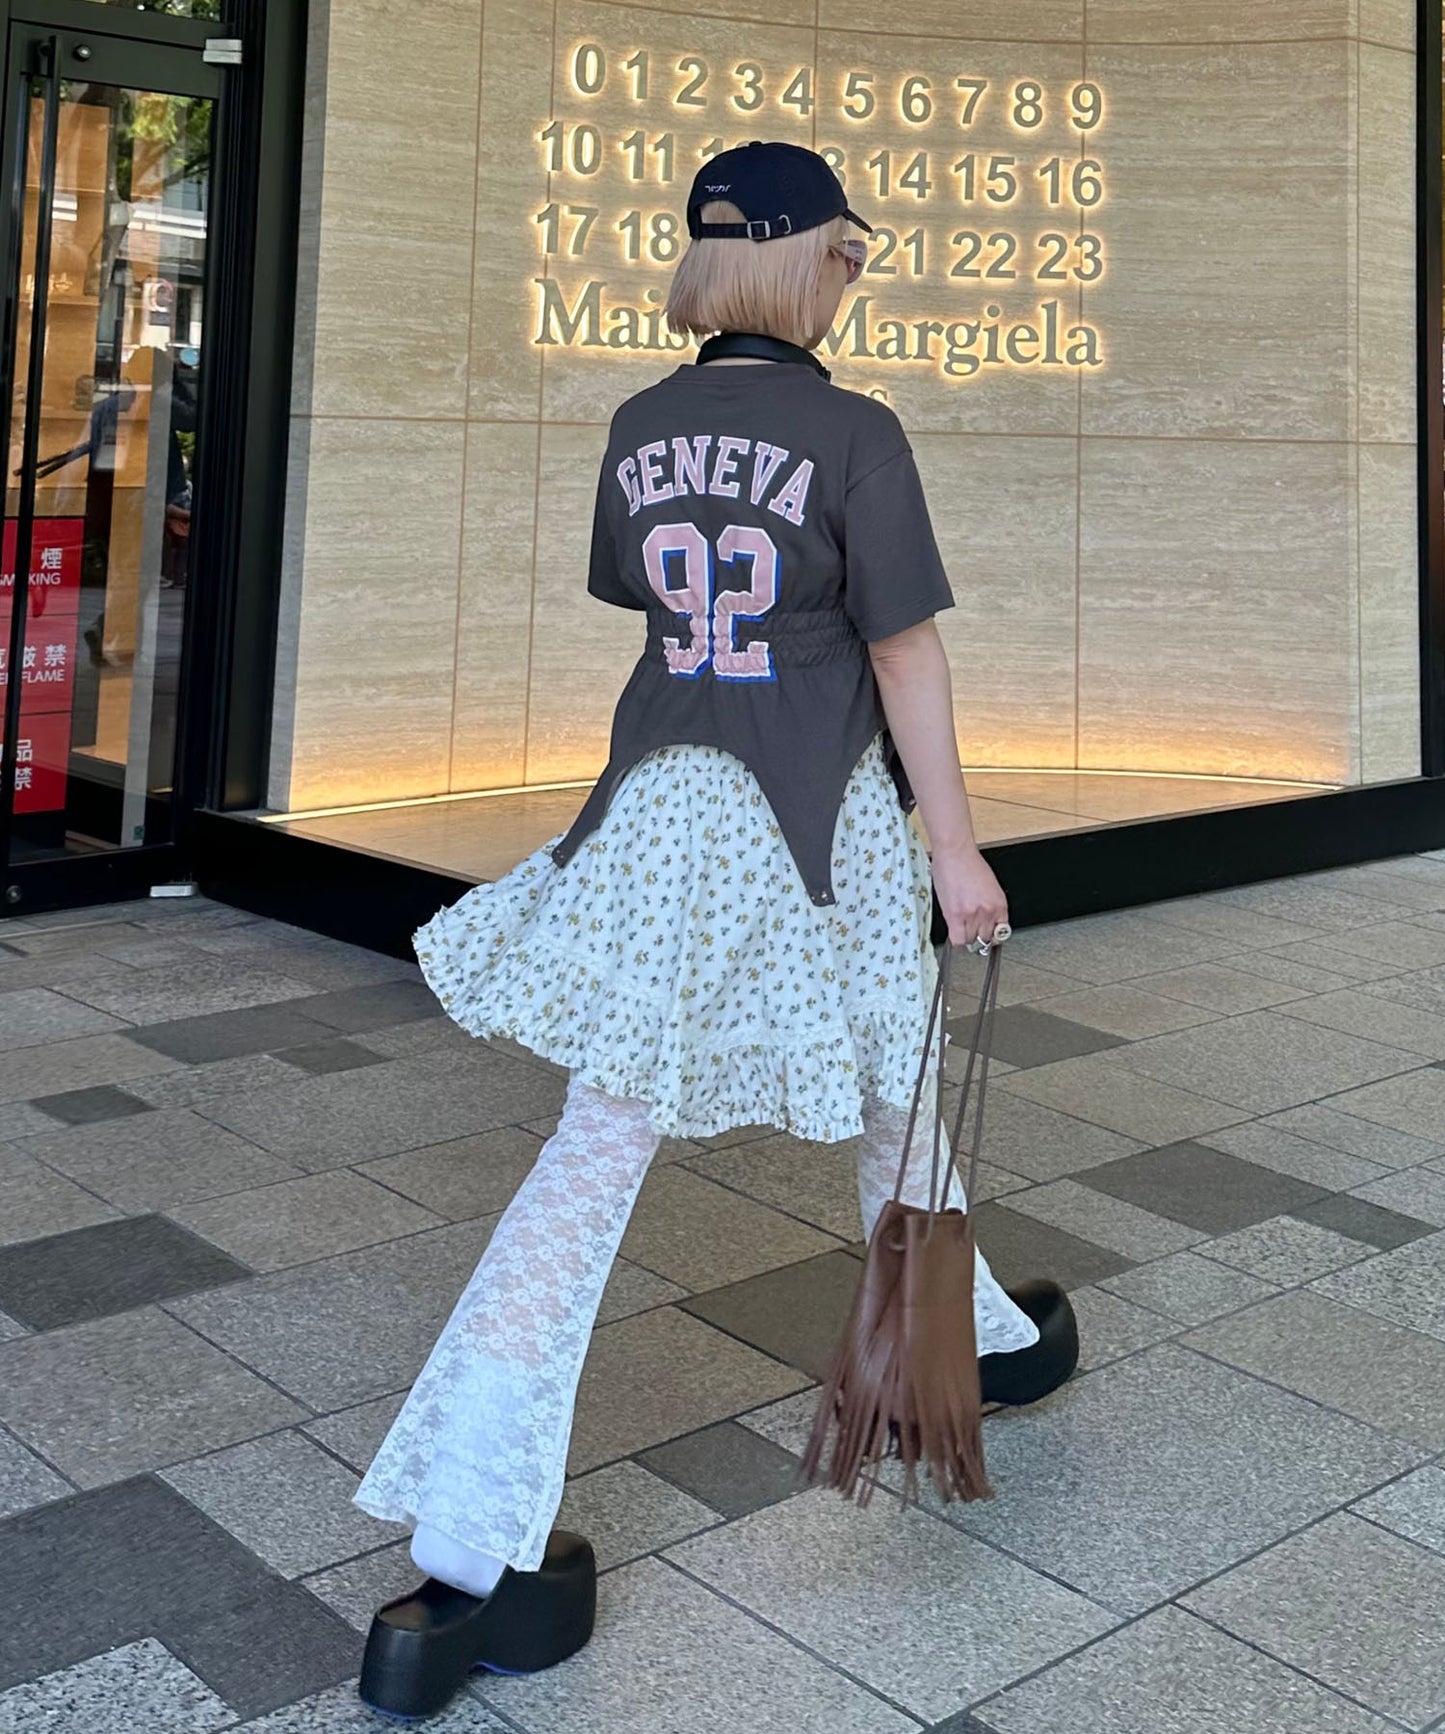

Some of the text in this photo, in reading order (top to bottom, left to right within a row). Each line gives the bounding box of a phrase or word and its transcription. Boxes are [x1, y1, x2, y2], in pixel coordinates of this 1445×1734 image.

[574, 43, 1103, 129] 0 1 2 3 4 5 6 7 8 9
[541, 121, 601, 175] 10
[622, 130, 674, 182] 11
[869, 150, 932, 199] 14
[954, 154, 1017, 203] 15
[1039, 157, 1103, 207] 16
[537, 203, 1103, 281] 17 18 21 22 23
[534, 278, 1103, 377] Mai Margiela
[616, 435, 815, 527] GENEVA
[0, 572, 61, 586] MKING
[642, 522, 782, 682] 92
